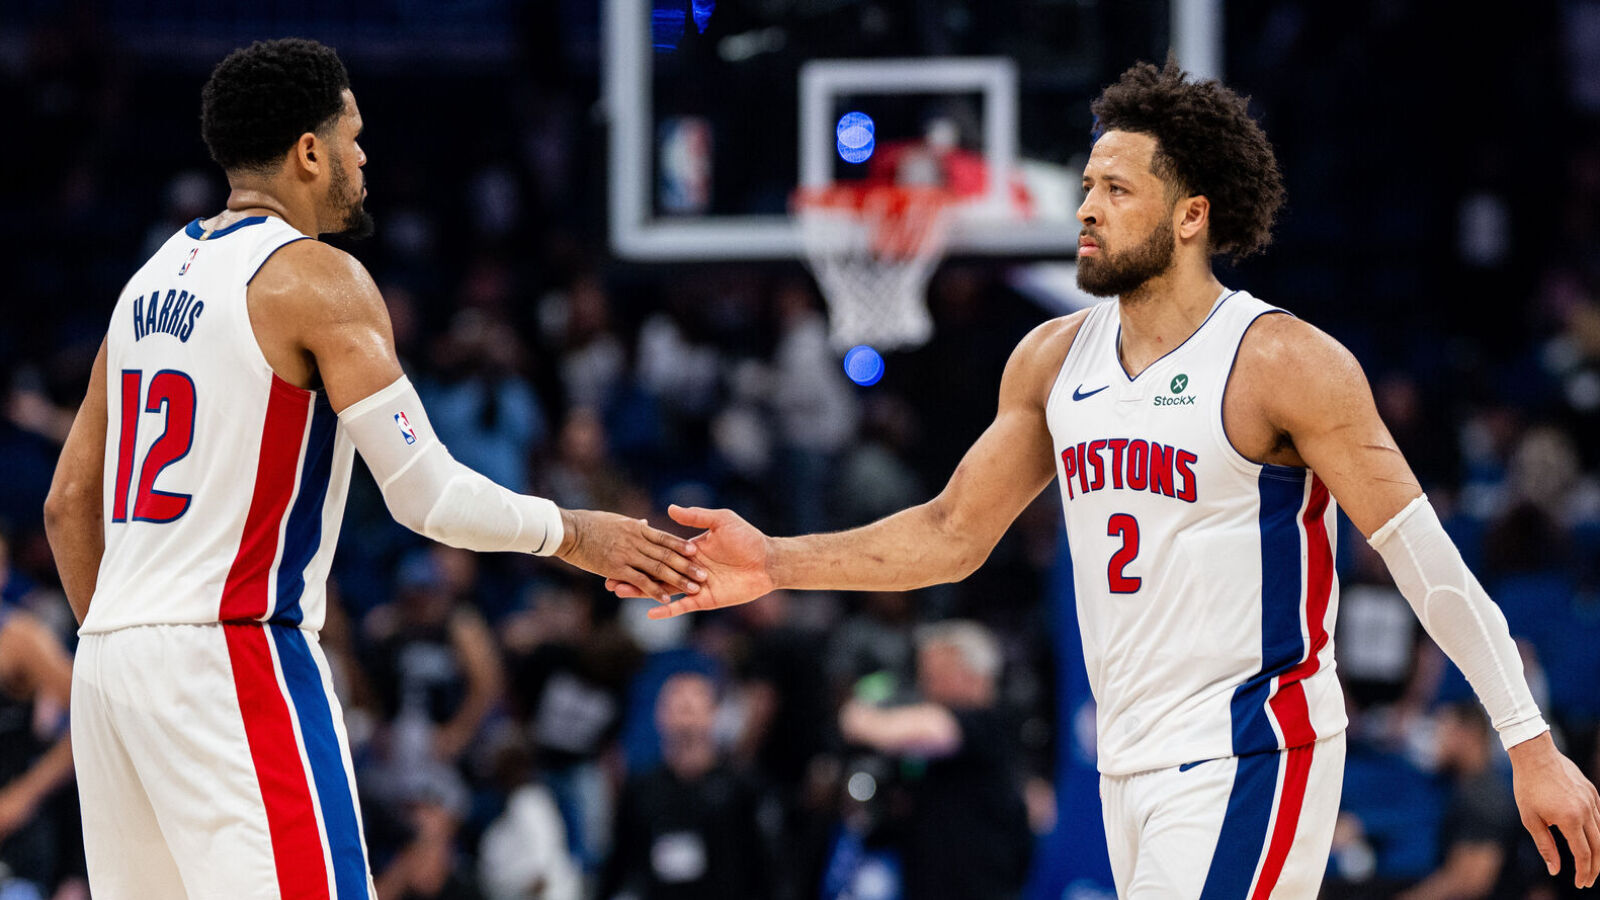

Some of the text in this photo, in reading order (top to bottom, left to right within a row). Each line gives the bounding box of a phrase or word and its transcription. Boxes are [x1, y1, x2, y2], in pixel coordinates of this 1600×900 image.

[133, 289, 205, 343] HARRIS
[1153, 395, 1197, 406] StockX
[112, 368, 197, 524] 12
[1061, 438, 1198, 503] PISTONS
[1107, 513, 1142, 594] 2
